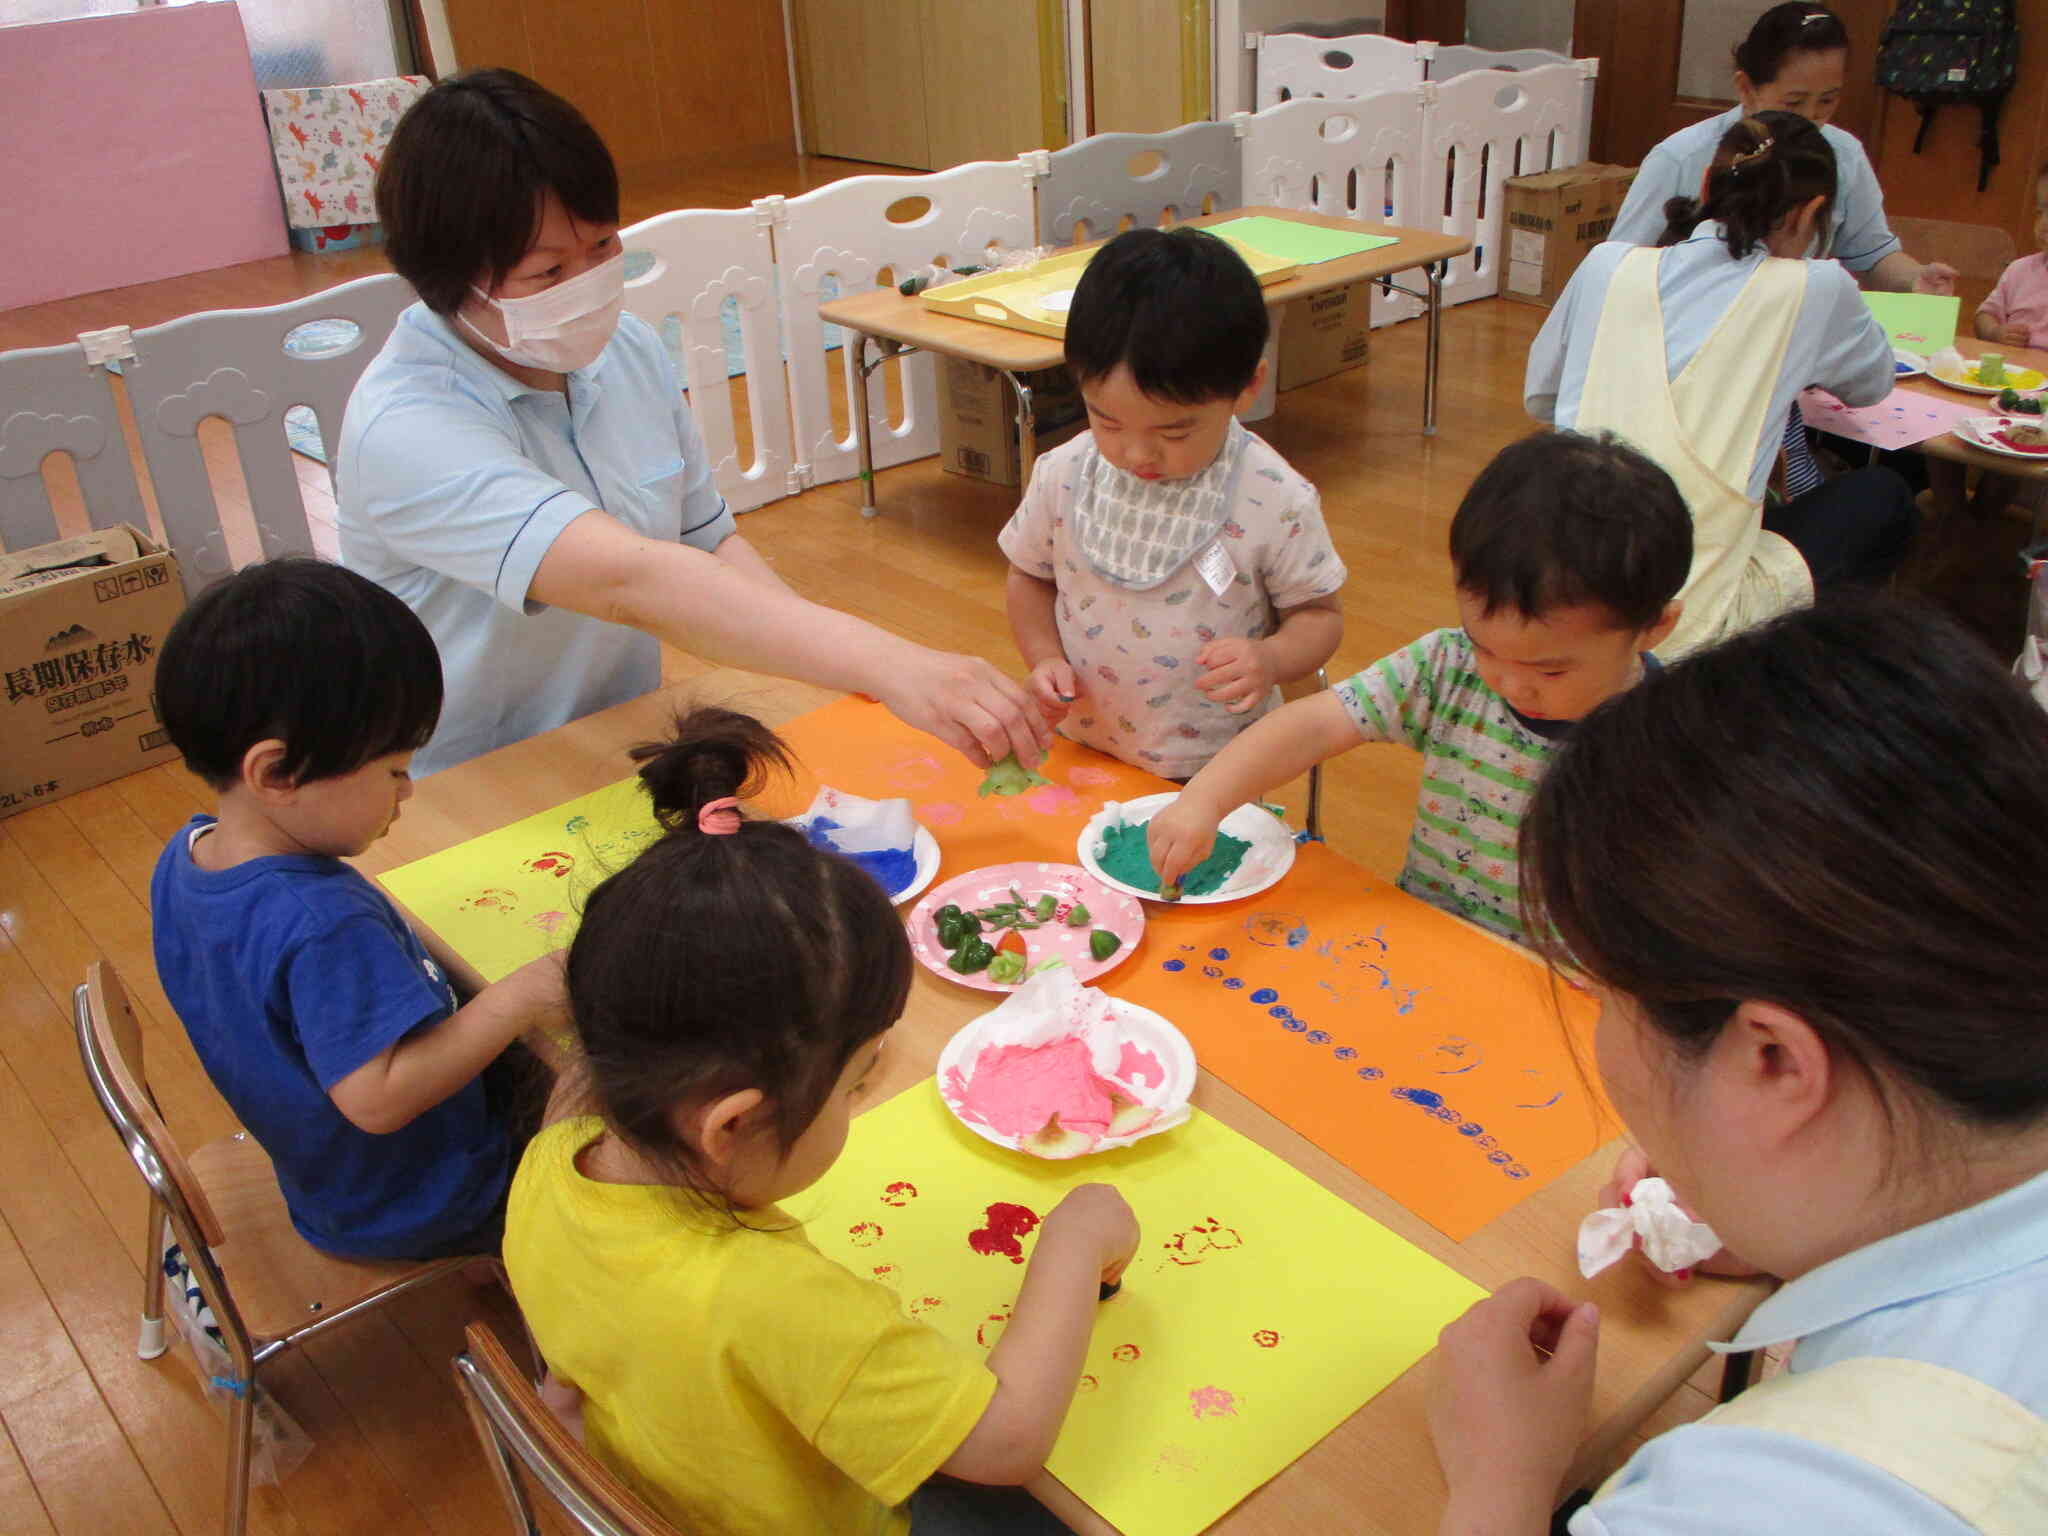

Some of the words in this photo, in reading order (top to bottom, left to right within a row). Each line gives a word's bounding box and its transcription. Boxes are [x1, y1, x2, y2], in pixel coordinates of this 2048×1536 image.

[4, 632, 154, 704] 長期保存水
